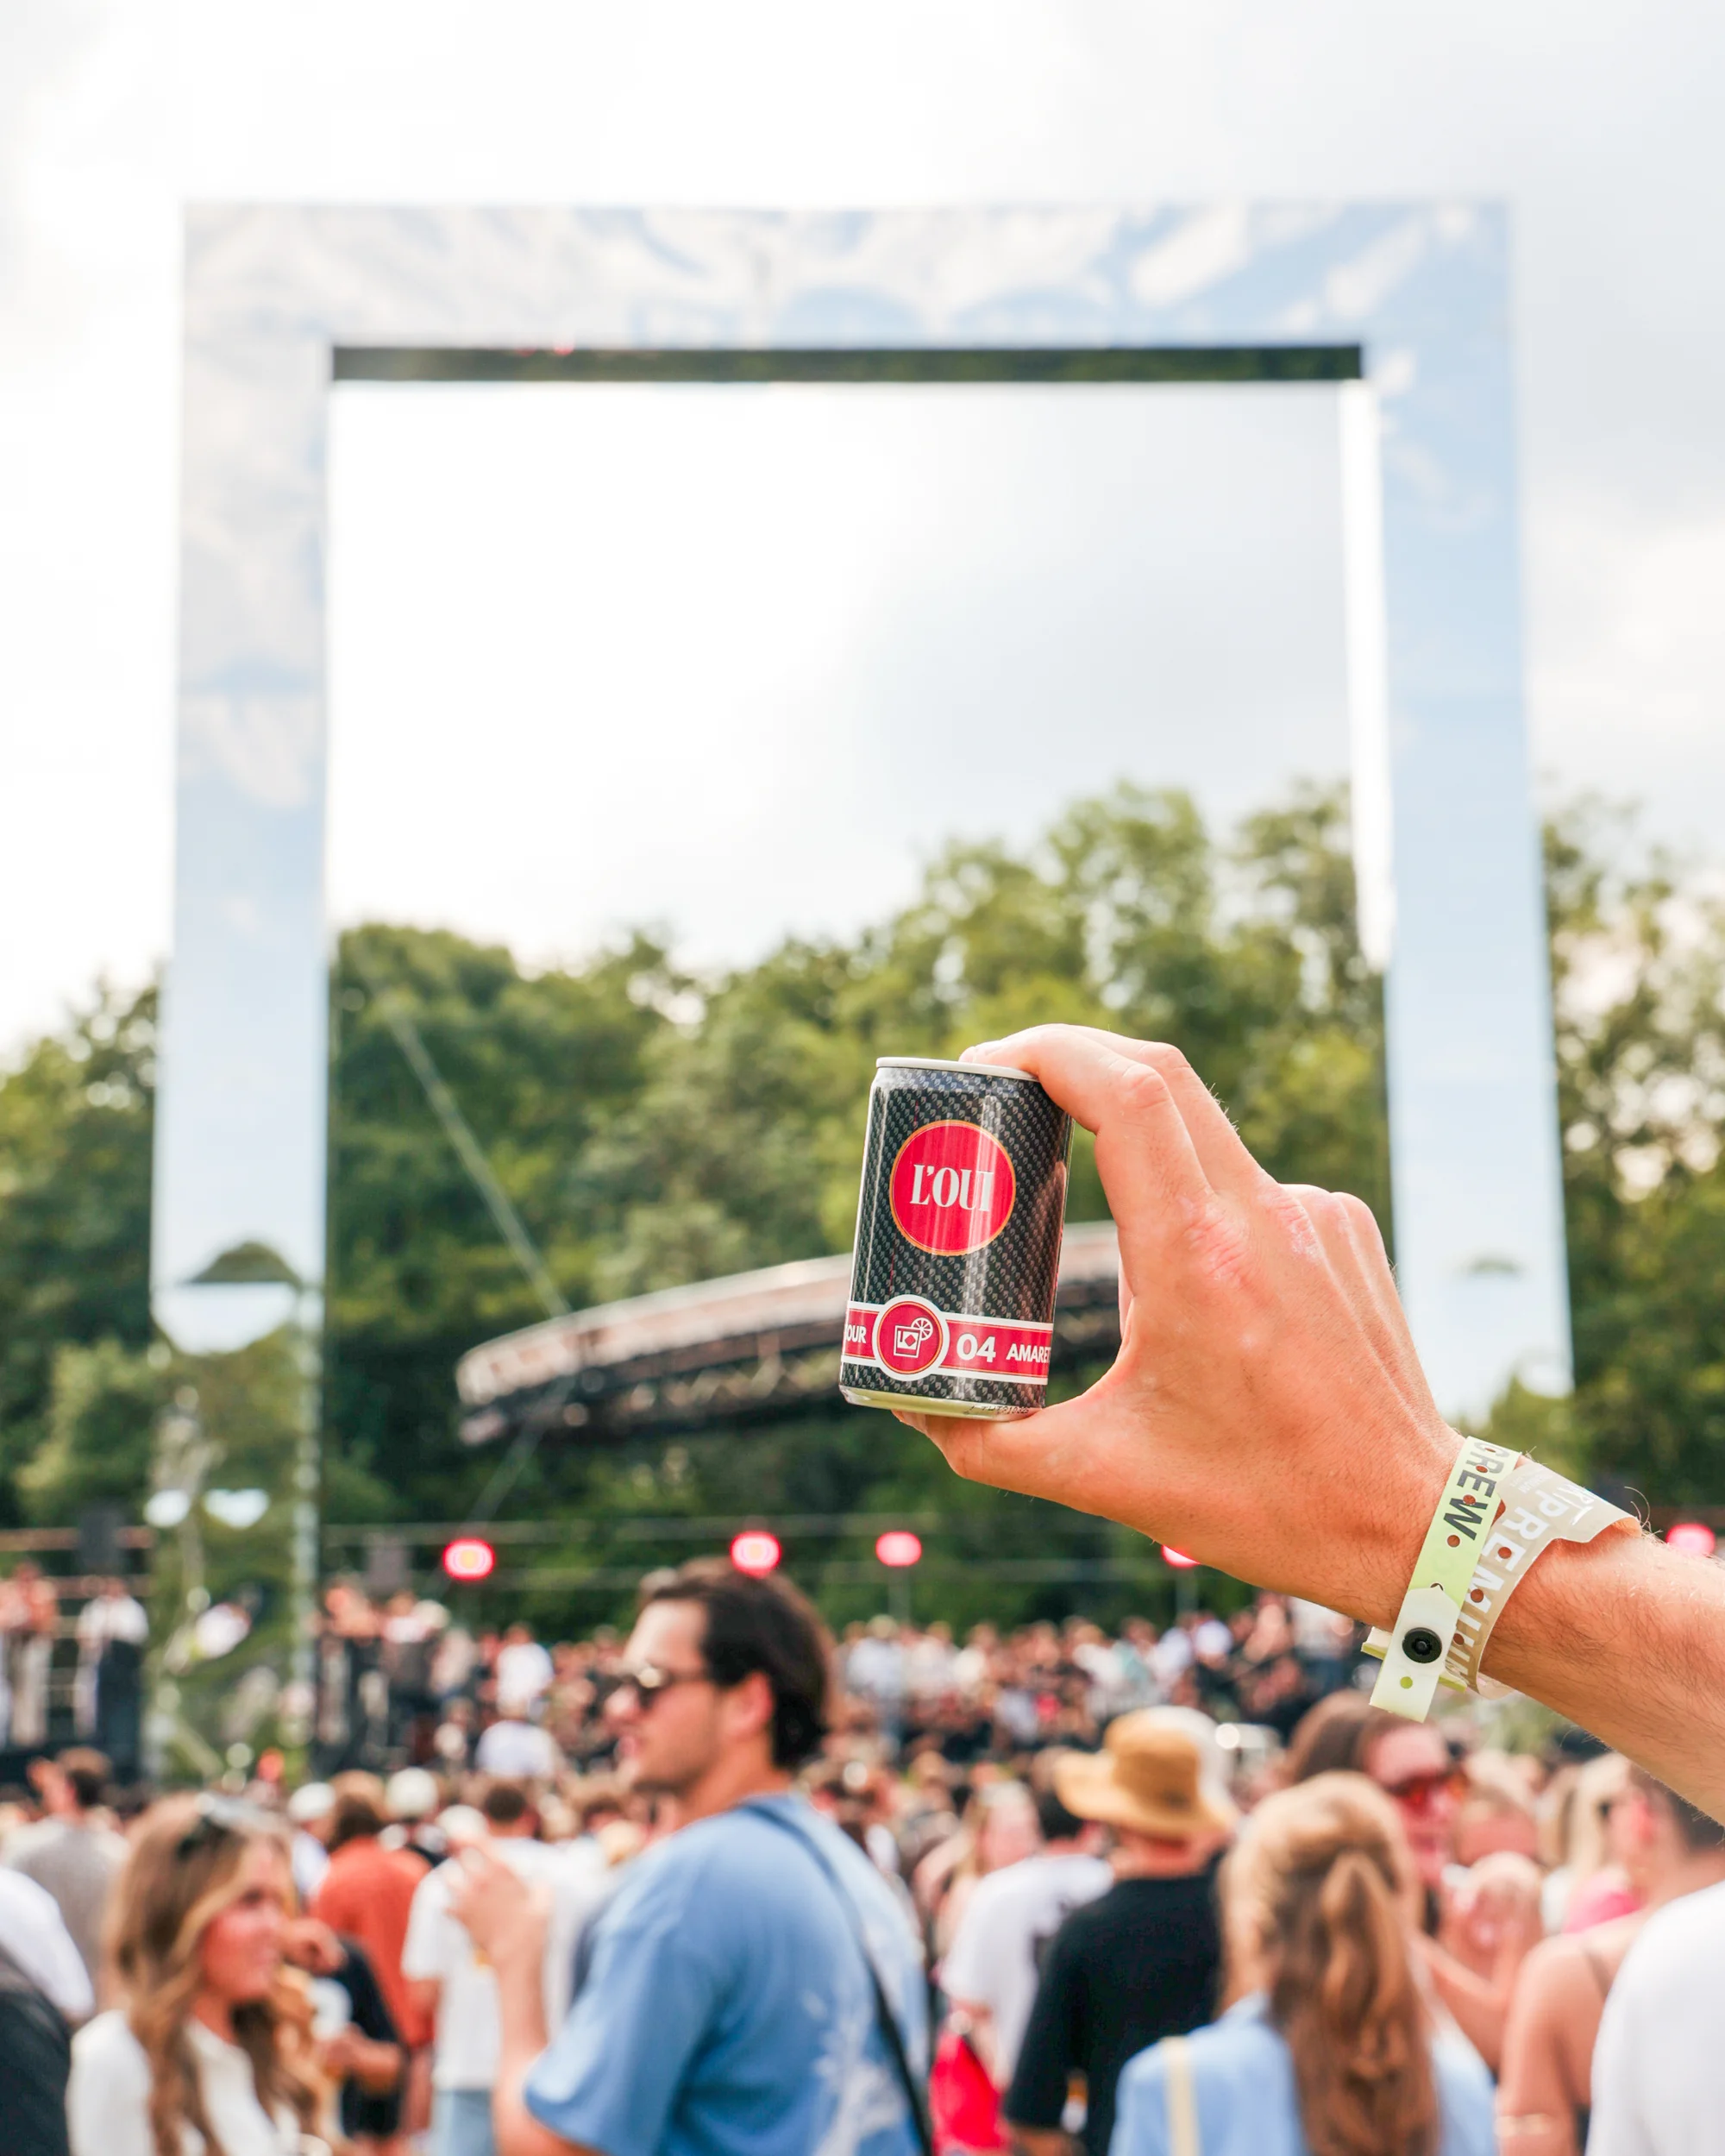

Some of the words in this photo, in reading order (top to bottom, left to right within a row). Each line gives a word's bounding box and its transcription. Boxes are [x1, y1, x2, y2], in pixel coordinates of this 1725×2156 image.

[909, 1163, 994, 1212] L'OUI
[845, 1323, 867, 1344] OUR
[957, 1333, 996, 1363] 04
[1443, 1442, 1509, 1541] CREW
